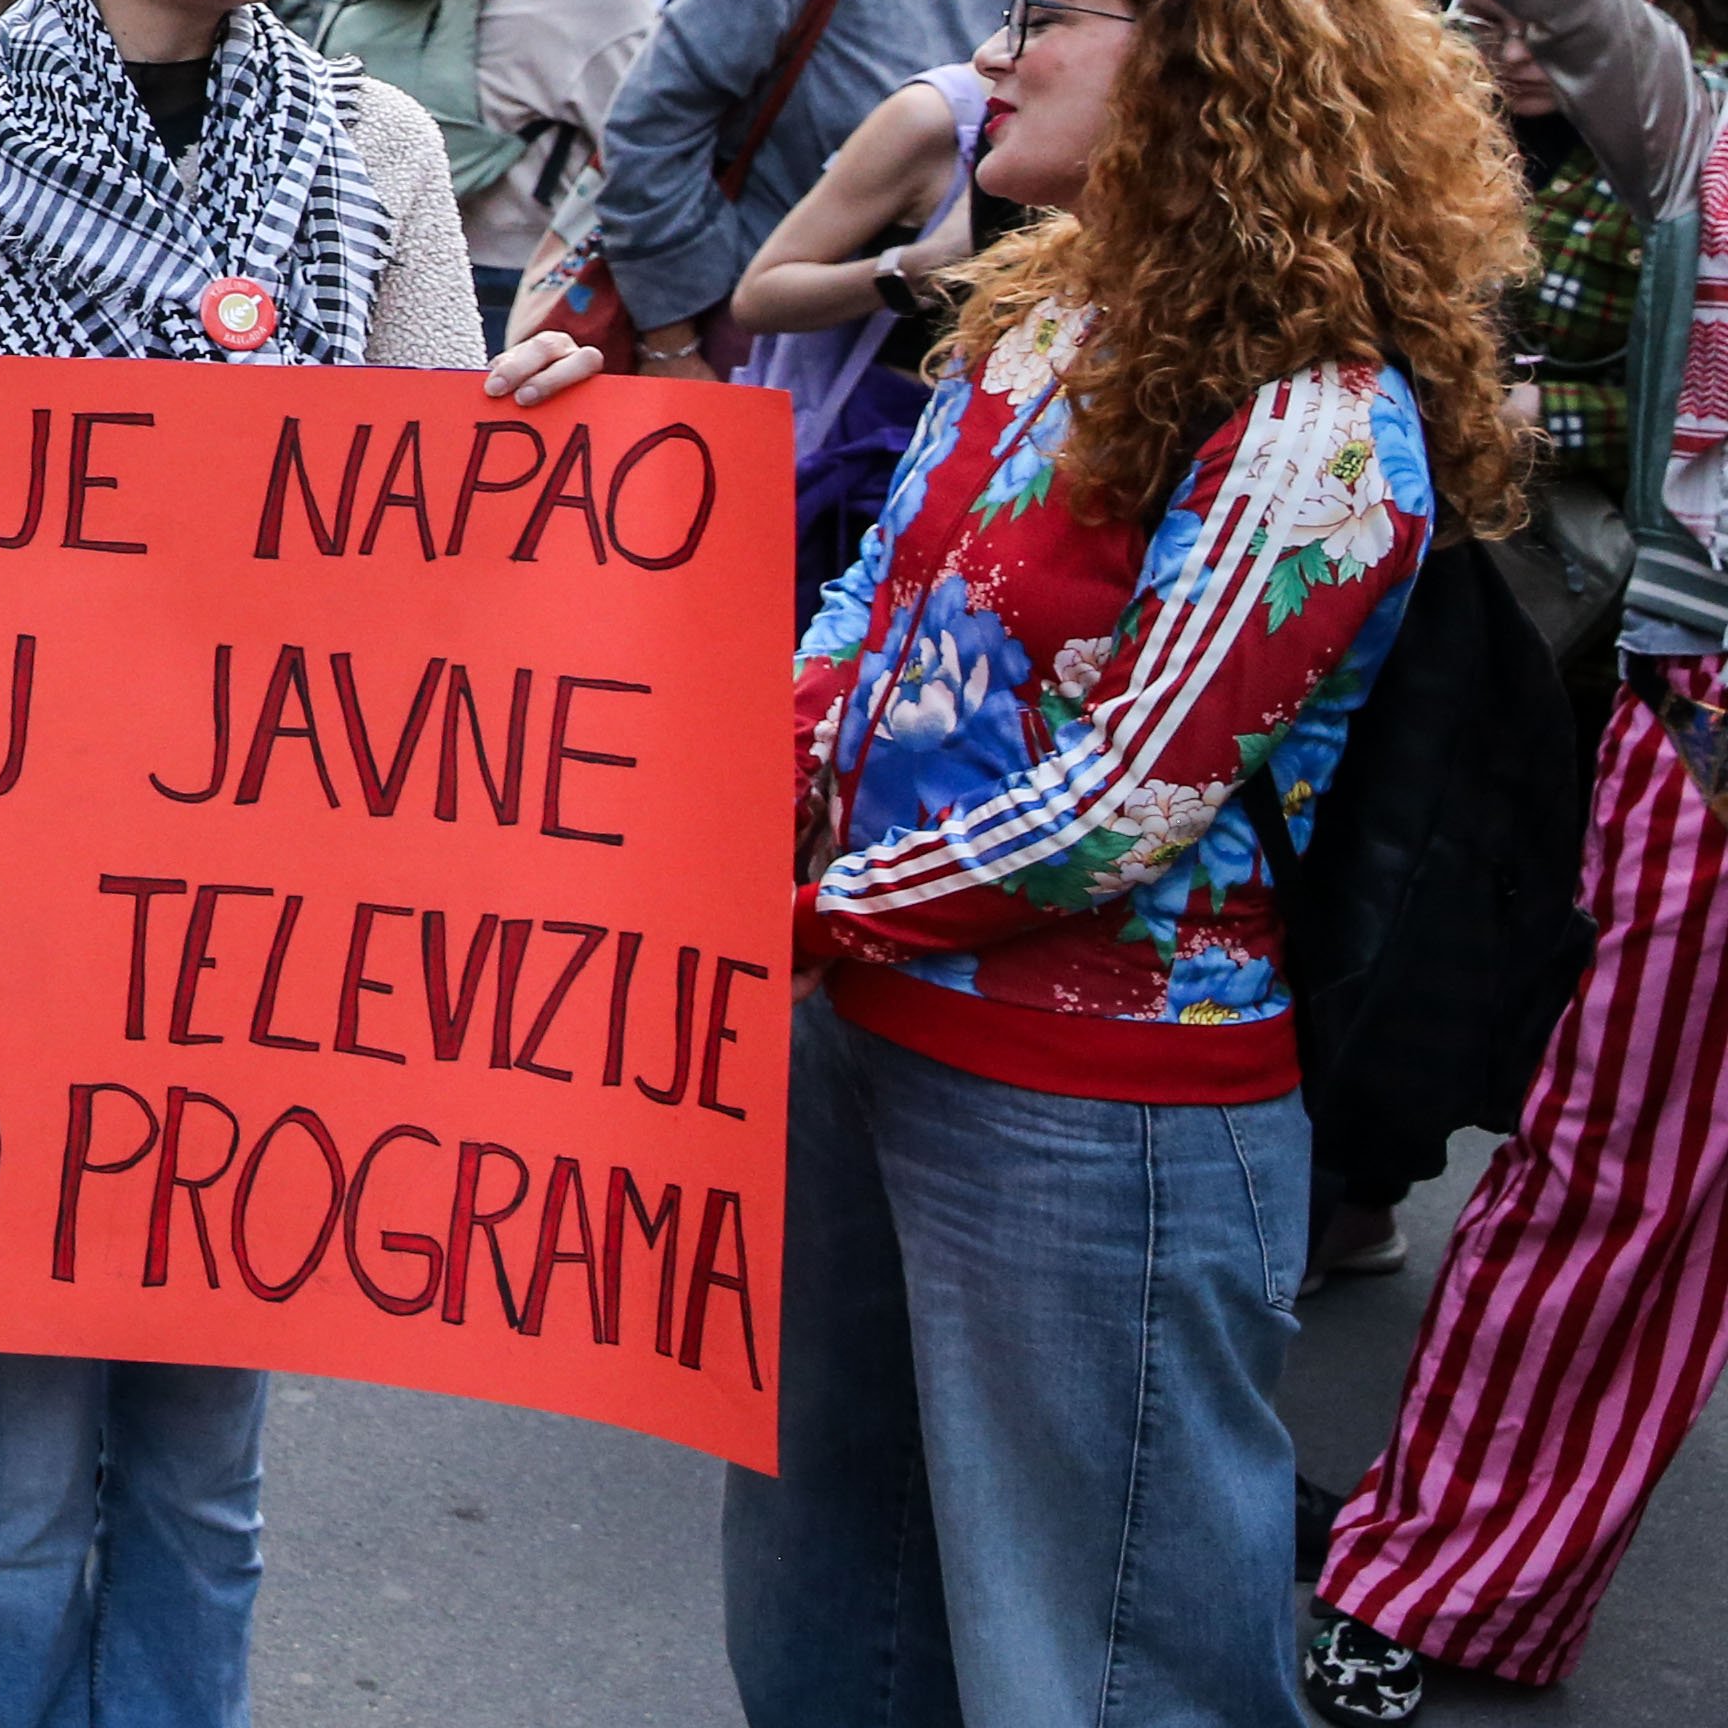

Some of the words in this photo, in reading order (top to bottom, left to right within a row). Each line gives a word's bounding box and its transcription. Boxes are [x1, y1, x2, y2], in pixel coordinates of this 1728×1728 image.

[253, 416, 717, 571] NAPAO
[148, 643, 652, 846] JAVNE
[99, 874, 770, 1121] TELEVIZIJE
[51, 1083, 764, 1392] PROGRAMA
